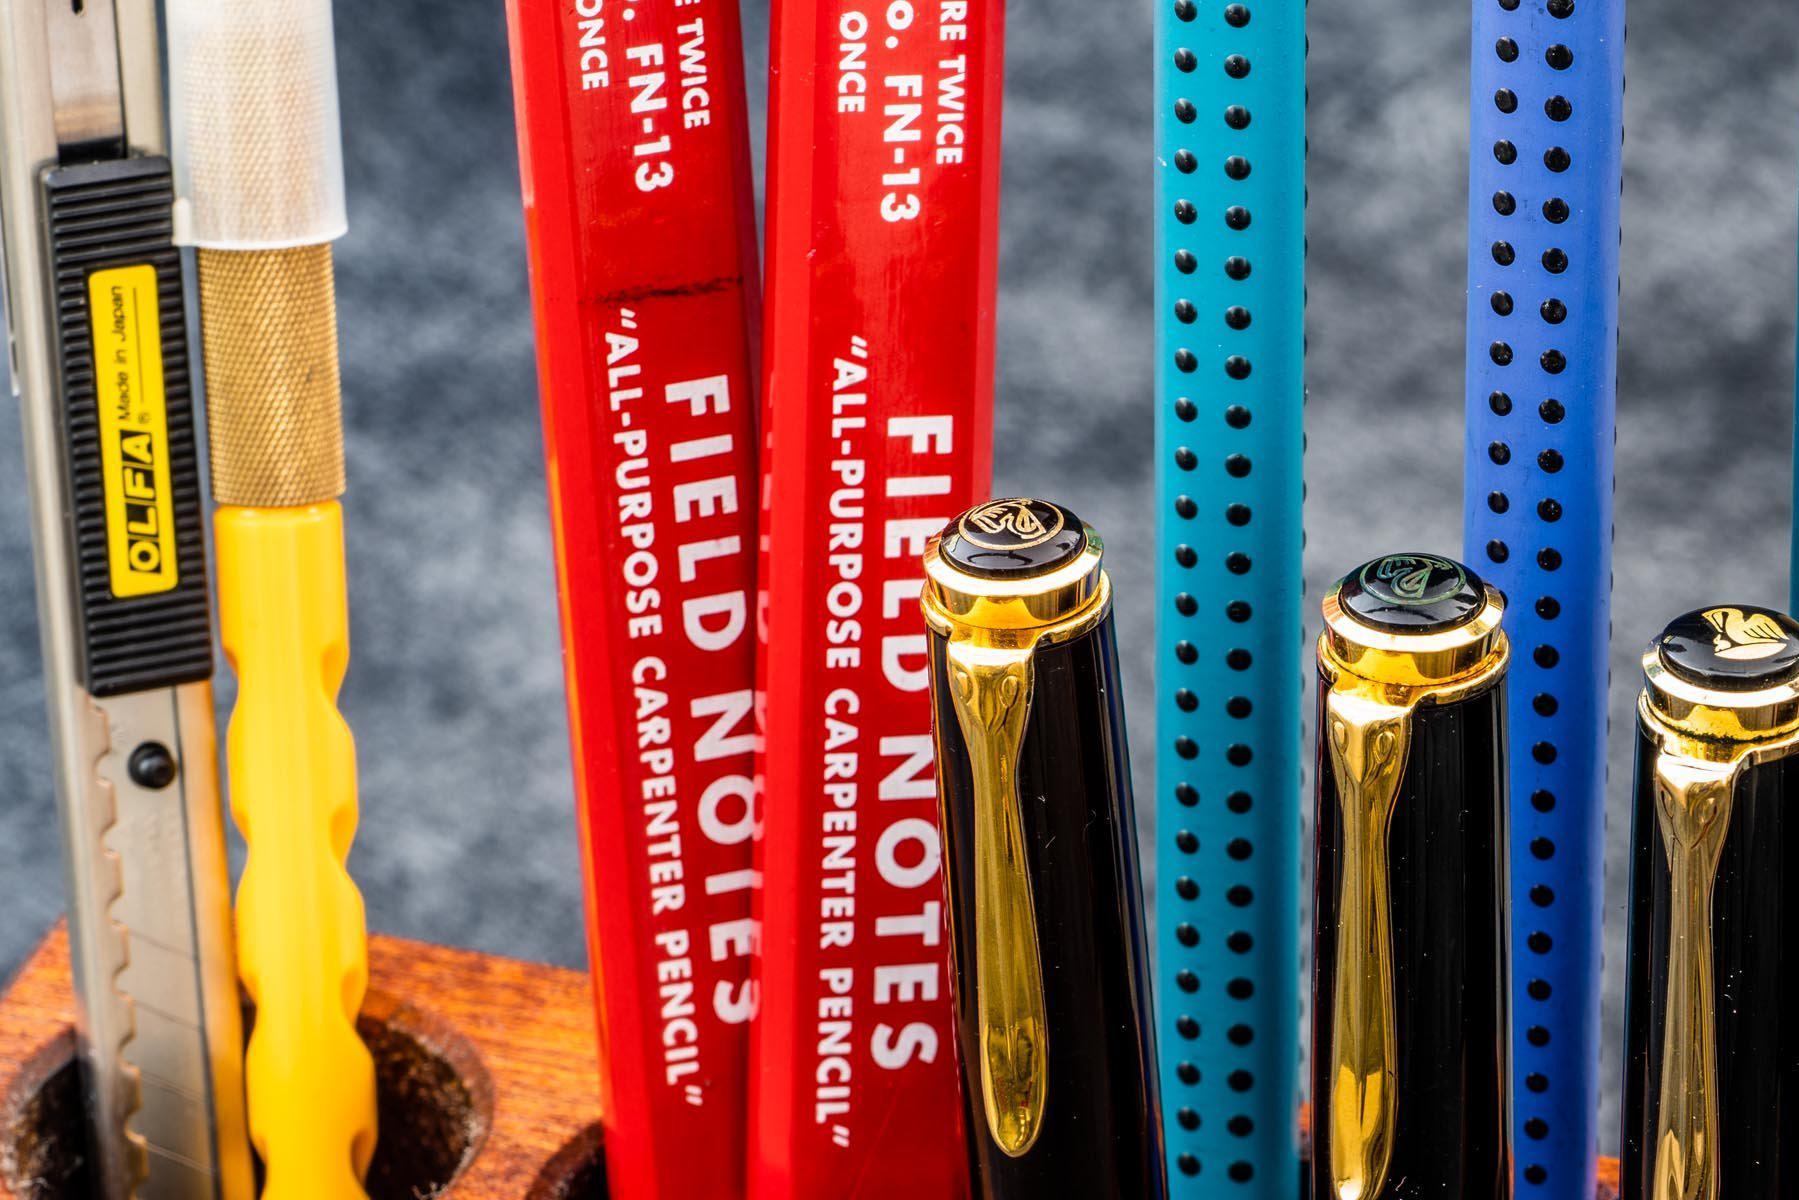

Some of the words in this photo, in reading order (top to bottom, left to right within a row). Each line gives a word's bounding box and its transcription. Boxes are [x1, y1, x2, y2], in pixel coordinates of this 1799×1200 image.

[576, 0, 608, 90] ONCE
[677, 18, 710, 129] TWICE
[837, 11, 868, 113] ONCE
[936, 54, 966, 165] TWICE
[626, 44, 673, 192] FN-13
[880, 74, 922, 222] FN-13
[109, 286, 127, 342] Japan
[114, 349, 126, 363] in
[117, 372, 132, 421] Made
[120, 430, 162, 574] OLFA
[664, 374, 747, 651] FIELD
[881, 414, 953, 692] FIELD
[632, 656, 685, 915] CARPENTER
[819, 688, 860, 950] CARPENTER
[871, 734, 940, 1071] NOTES
